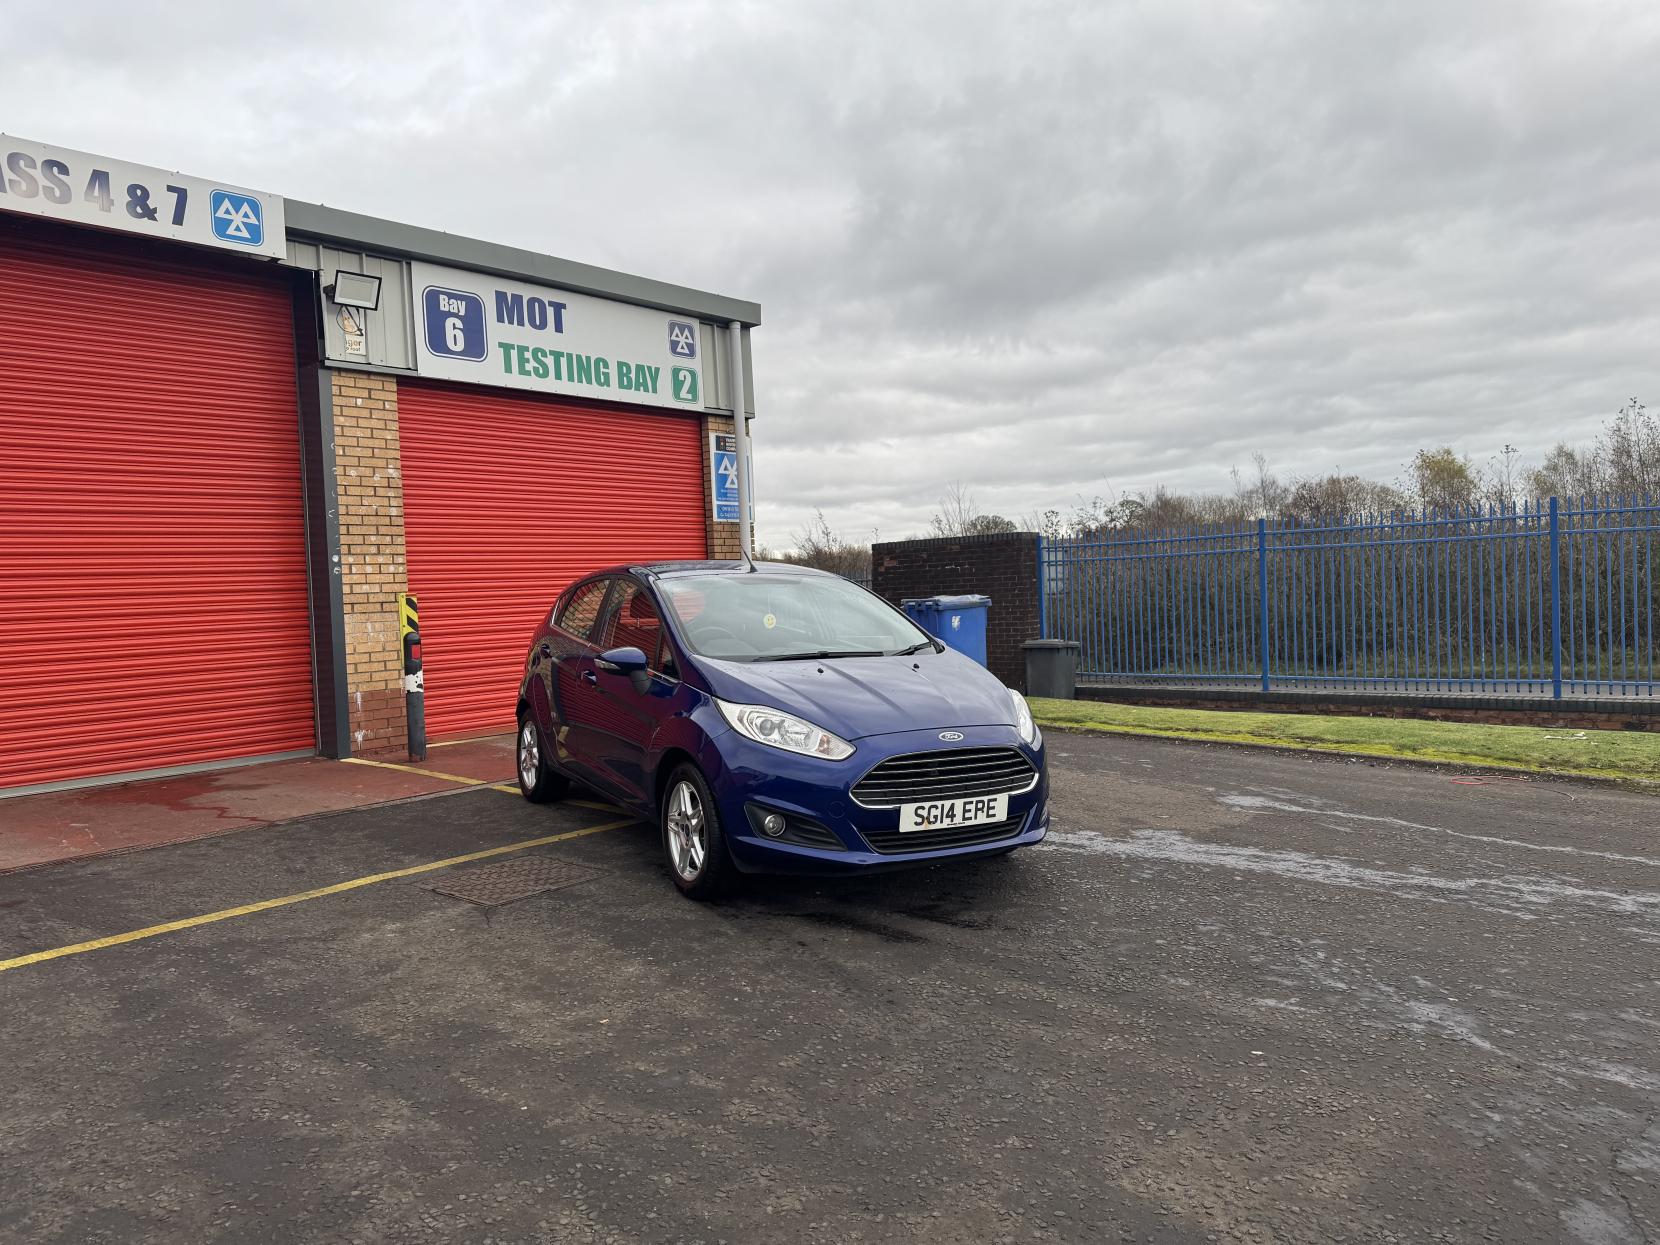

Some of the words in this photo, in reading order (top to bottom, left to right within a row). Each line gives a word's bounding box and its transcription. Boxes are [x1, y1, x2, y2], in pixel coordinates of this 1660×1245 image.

[0, 152, 72, 205] SS
[84, 169, 115, 214] 4
[126, 183, 158, 222] &
[166, 184, 188, 227] 7
[439, 294, 466, 317] Bay
[494, 289, 567, 334] MOT
[445, 317, 465, 352] 6
[497, 341, 611, 388] TESTING
[616, 360, 661, 394] BAY
[678, 369, 693, 399] 2
[914, 802, 956, 826] SG14
